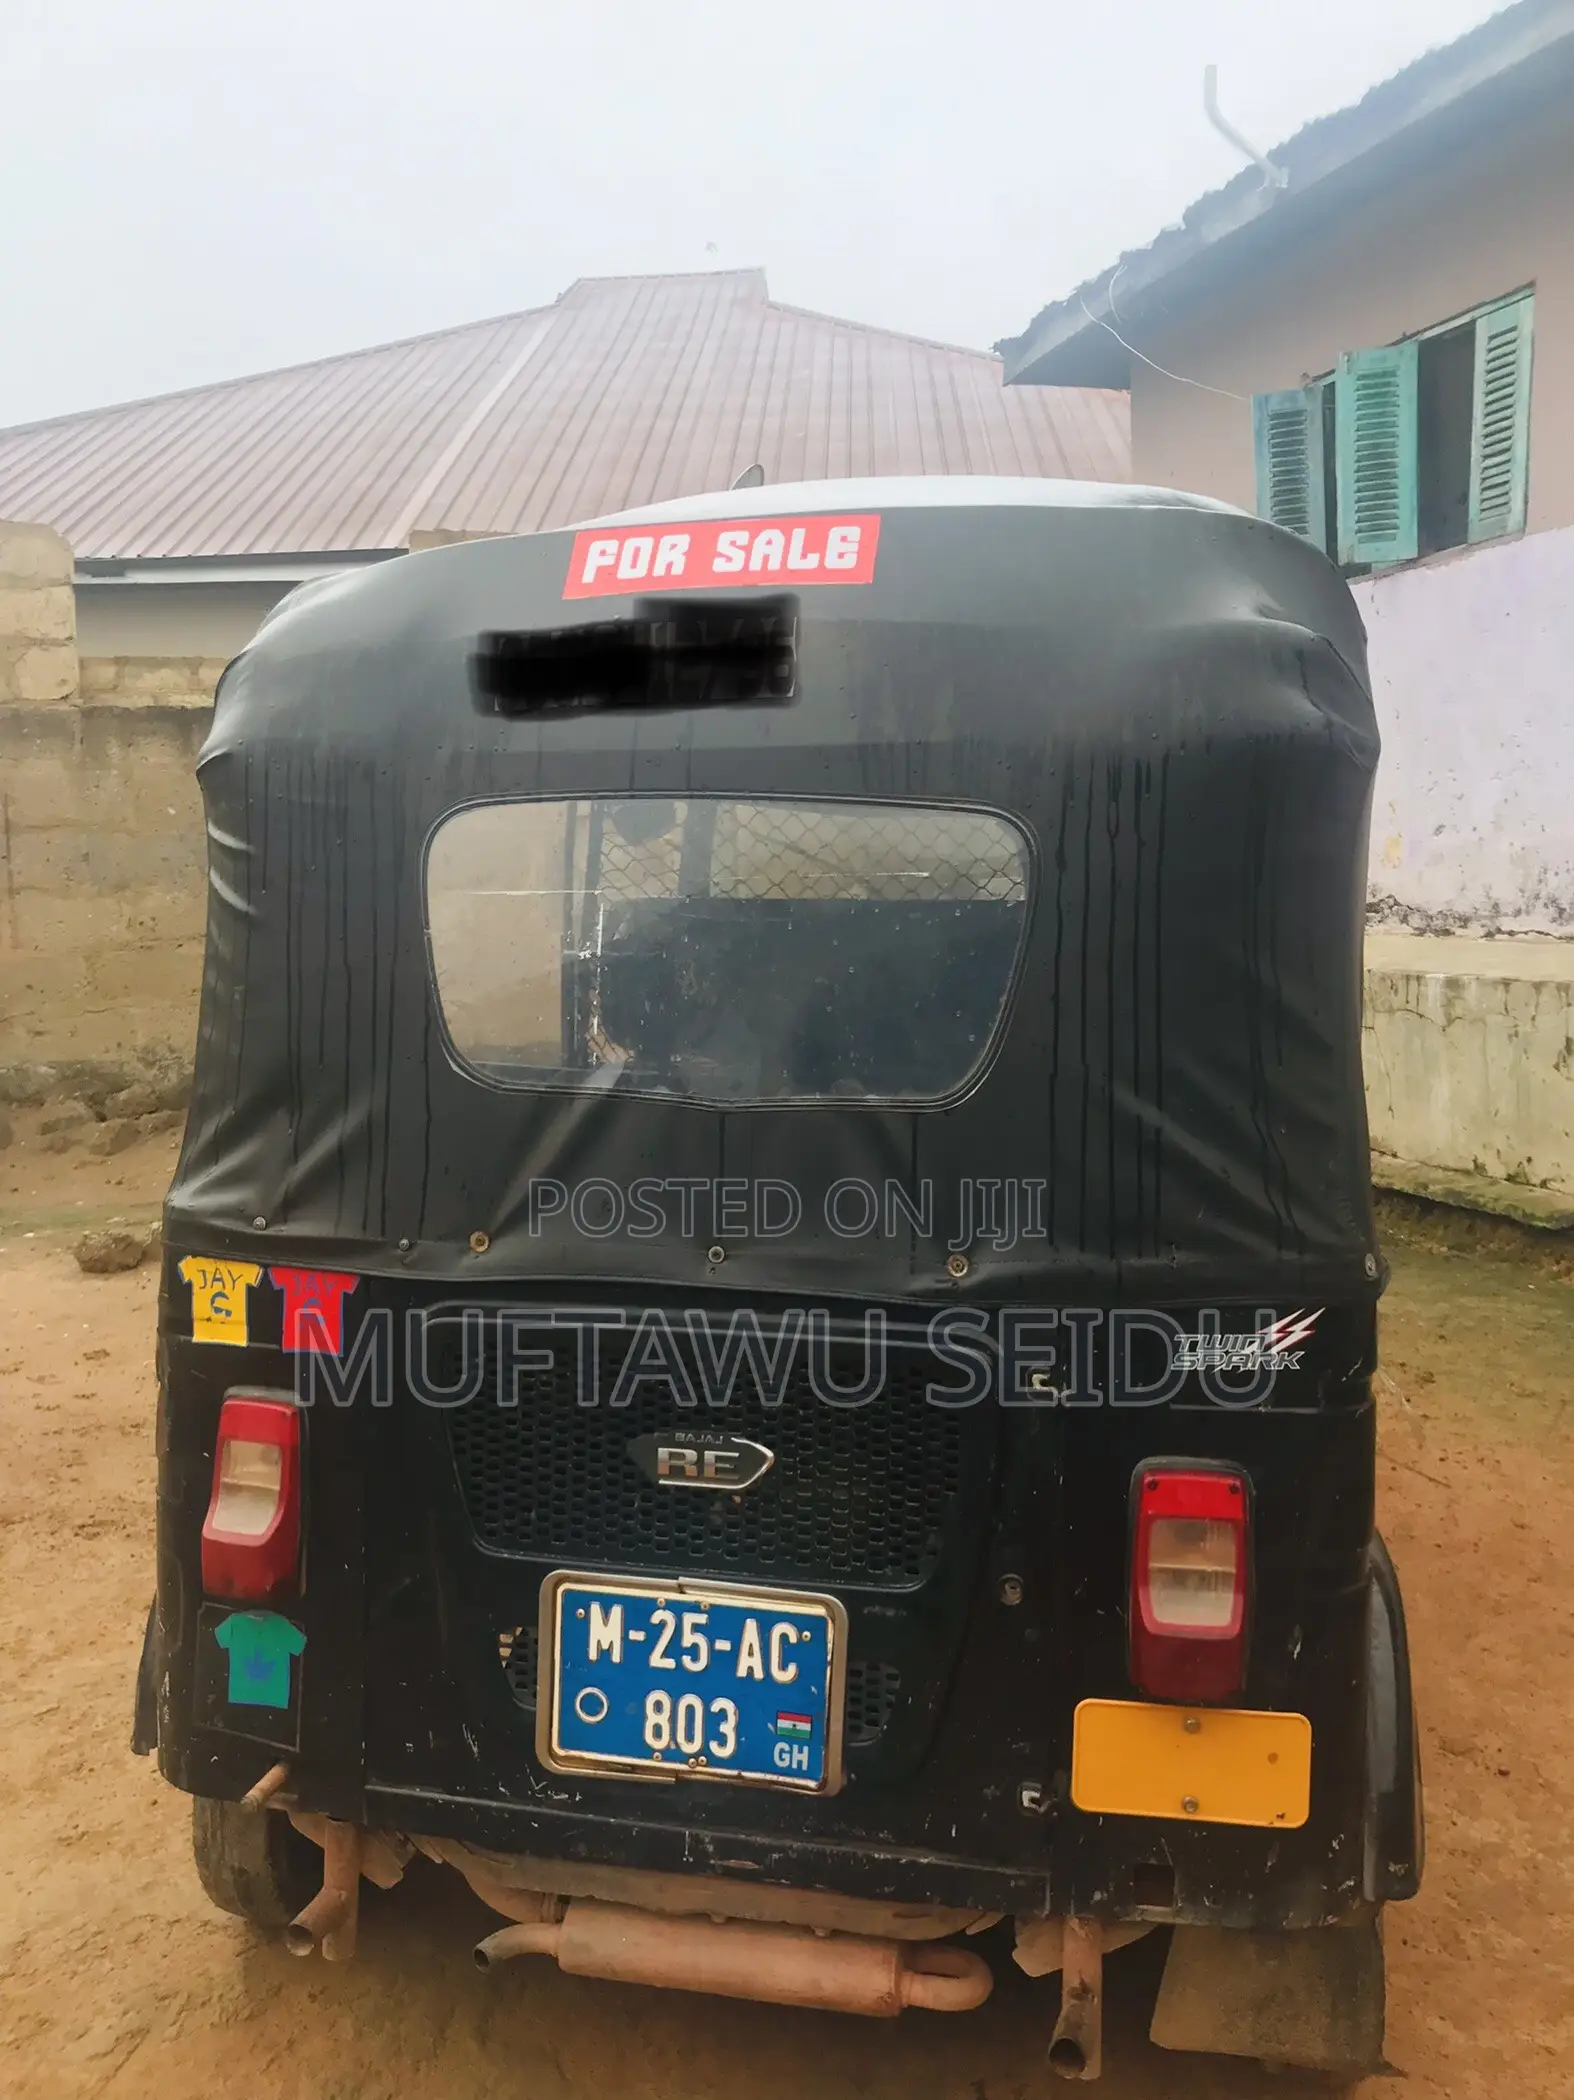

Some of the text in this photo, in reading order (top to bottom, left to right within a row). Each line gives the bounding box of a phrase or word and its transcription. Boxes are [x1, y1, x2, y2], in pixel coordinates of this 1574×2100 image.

[581, 526, 862, 584] FOR SALE
[197, 1267, 244, 1291] JAY
[1171, 1351, 1305, 1373] SPARK
[674, 1432, 724, 1445] BAJAJ
[656, 1447, 740, 1479] RE
[586, 1601, 801, 1684] M-25-AC
[643, 1689, 739, 1759] 803
[773, 1742, 809, 1771] GH
